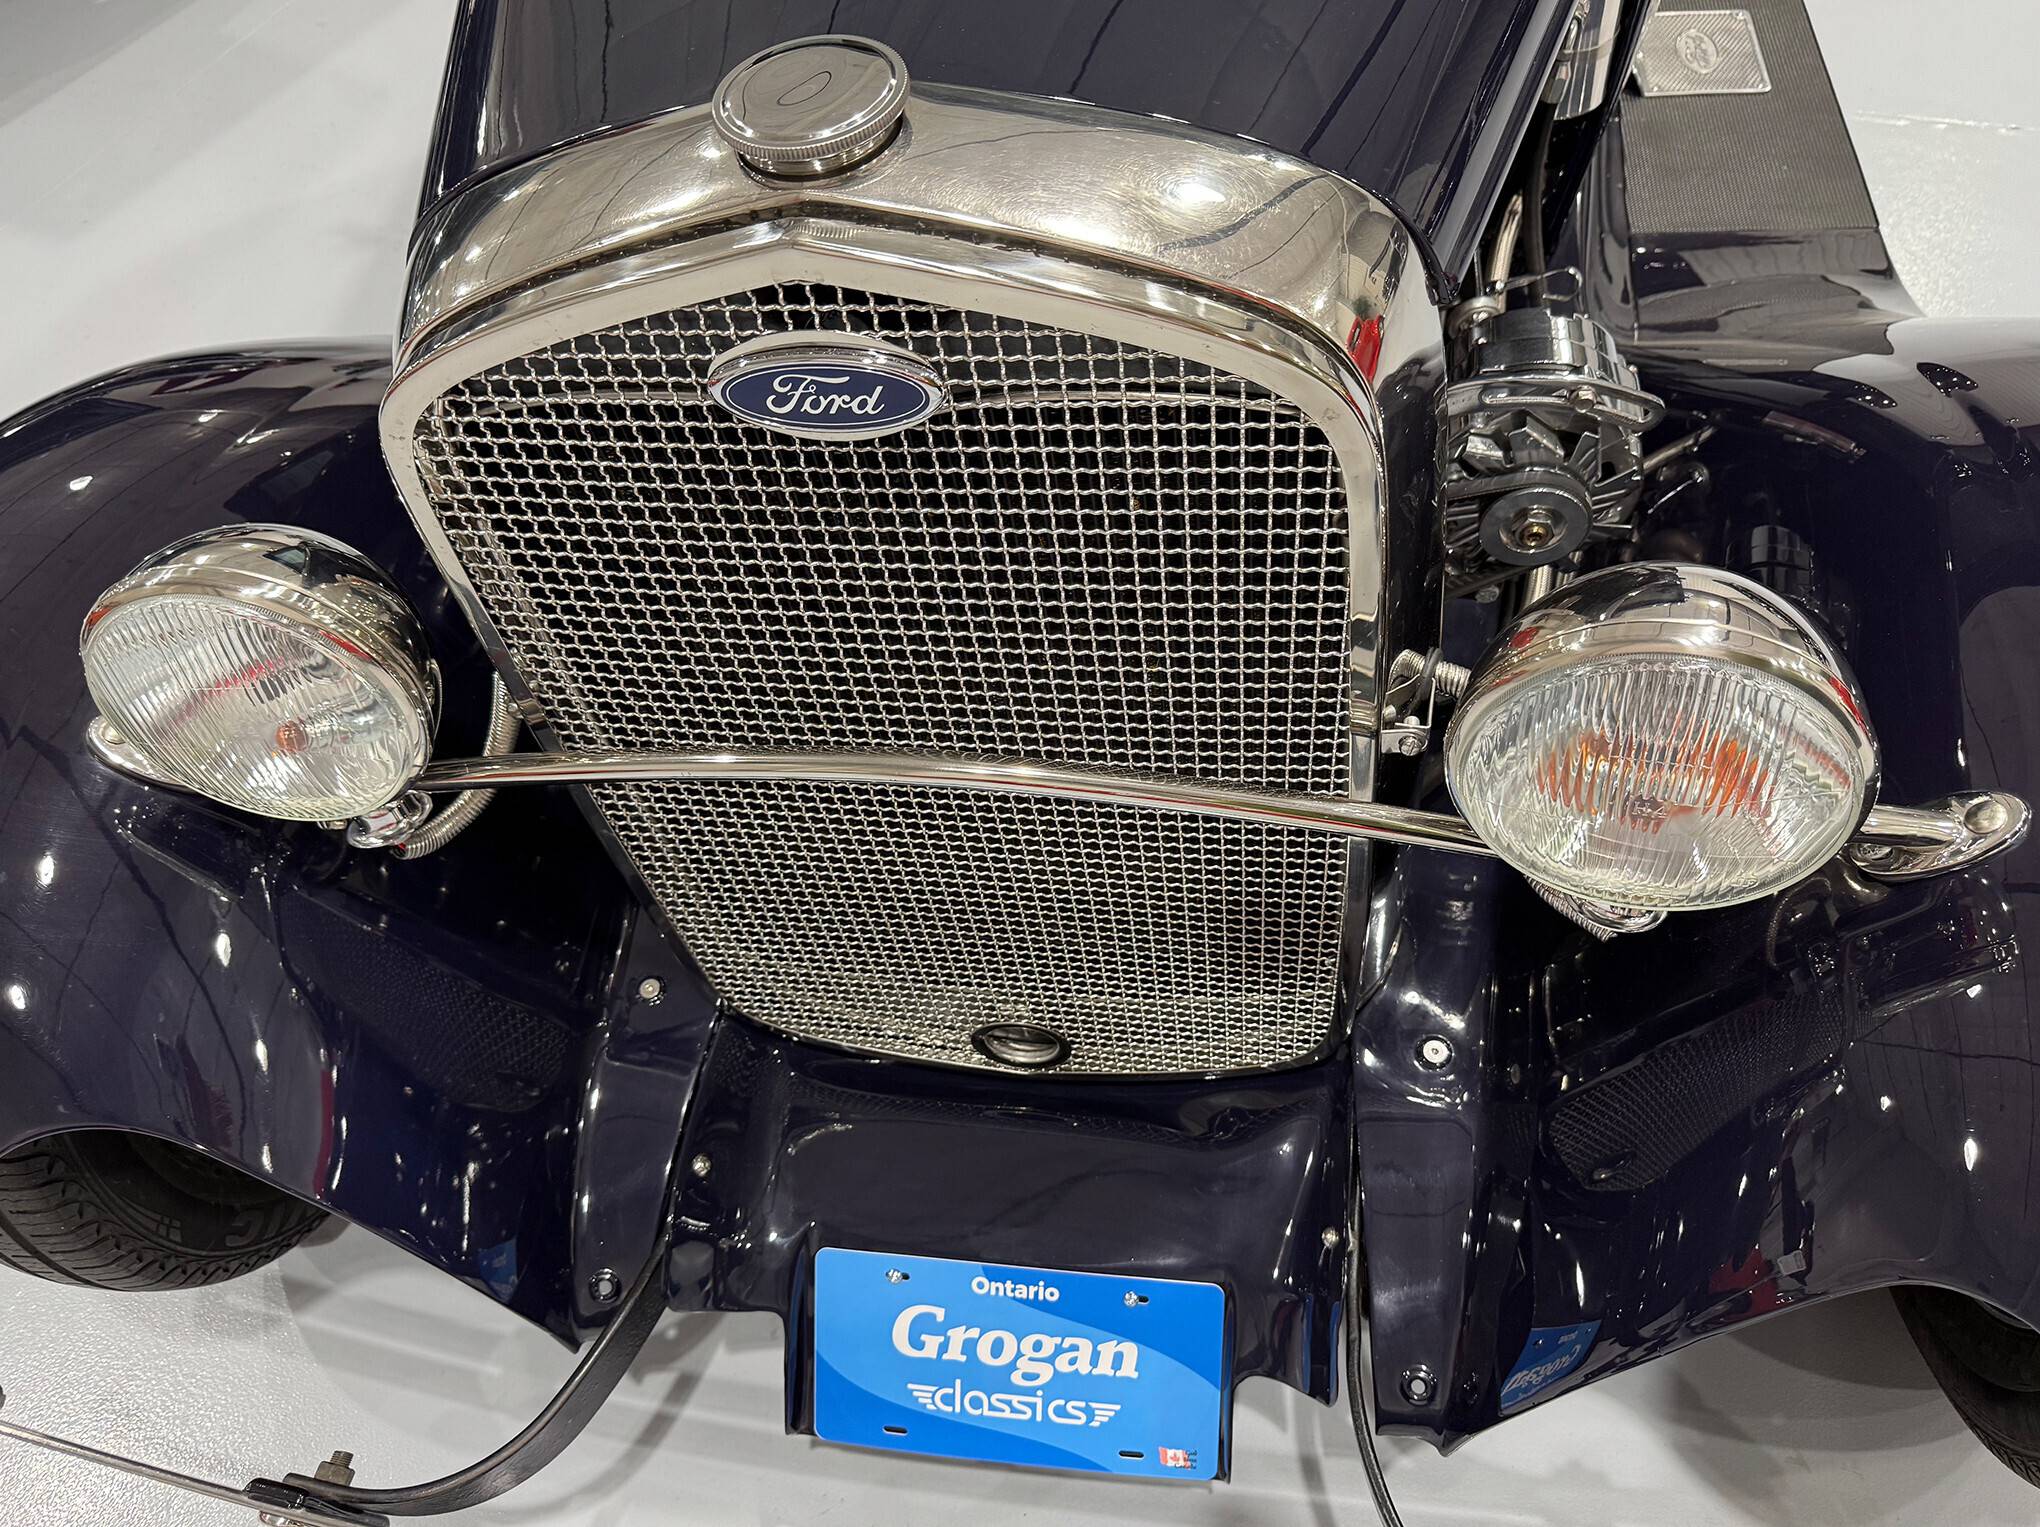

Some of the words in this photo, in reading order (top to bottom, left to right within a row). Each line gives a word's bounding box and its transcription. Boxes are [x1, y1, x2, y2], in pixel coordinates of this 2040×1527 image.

[766, 373, 885, 415] Ford
[971, 1276, 1060, 1302] Ontario
[891, 1304, 1140, 1387] Grogan
[933, 1378, 1088, 1426] classics
